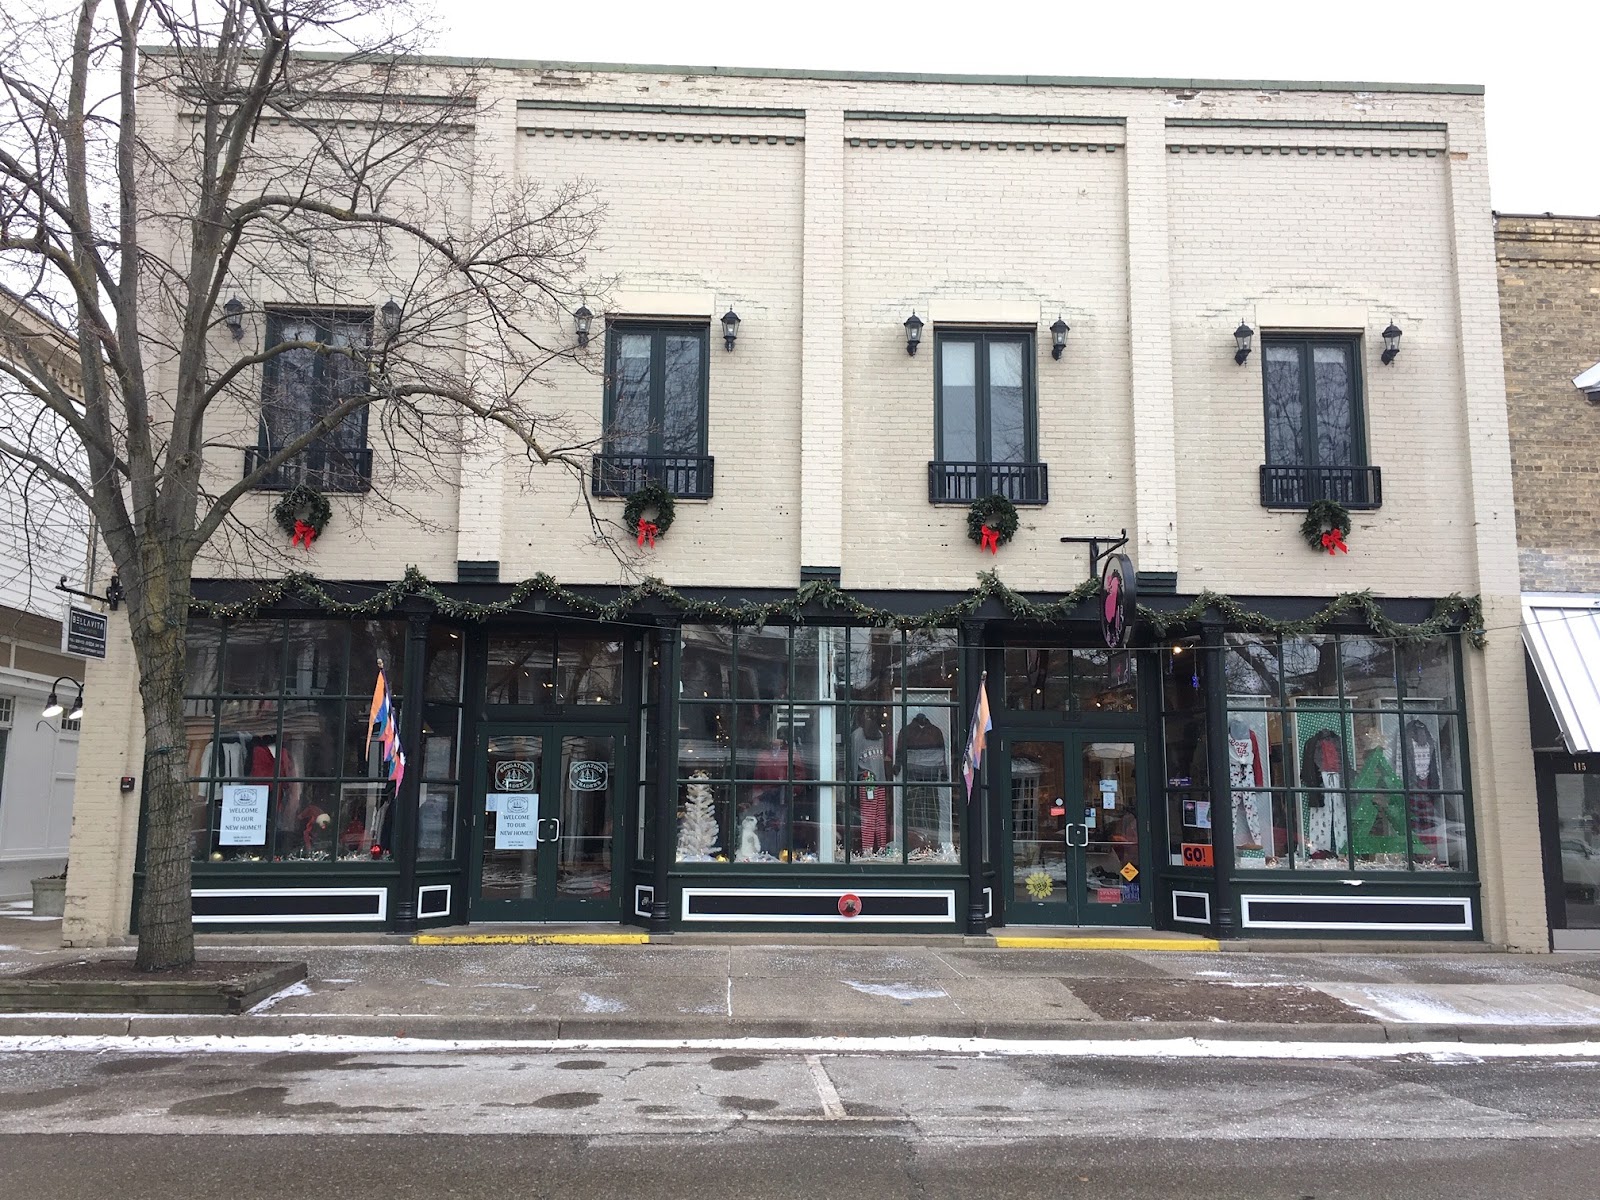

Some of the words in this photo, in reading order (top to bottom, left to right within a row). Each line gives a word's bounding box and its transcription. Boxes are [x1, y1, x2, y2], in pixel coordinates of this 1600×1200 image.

[73, 615, 104, 630] BELLAVITA
[499, 763, 530, 774] SAUGATUCK
[573, 763, 604, 774] SAUGATUCK
[1573, 762, 1587, 771] 115
[575, 780, 602, 789] TRADERS
[1184, 847, 1206, 862] GO!
